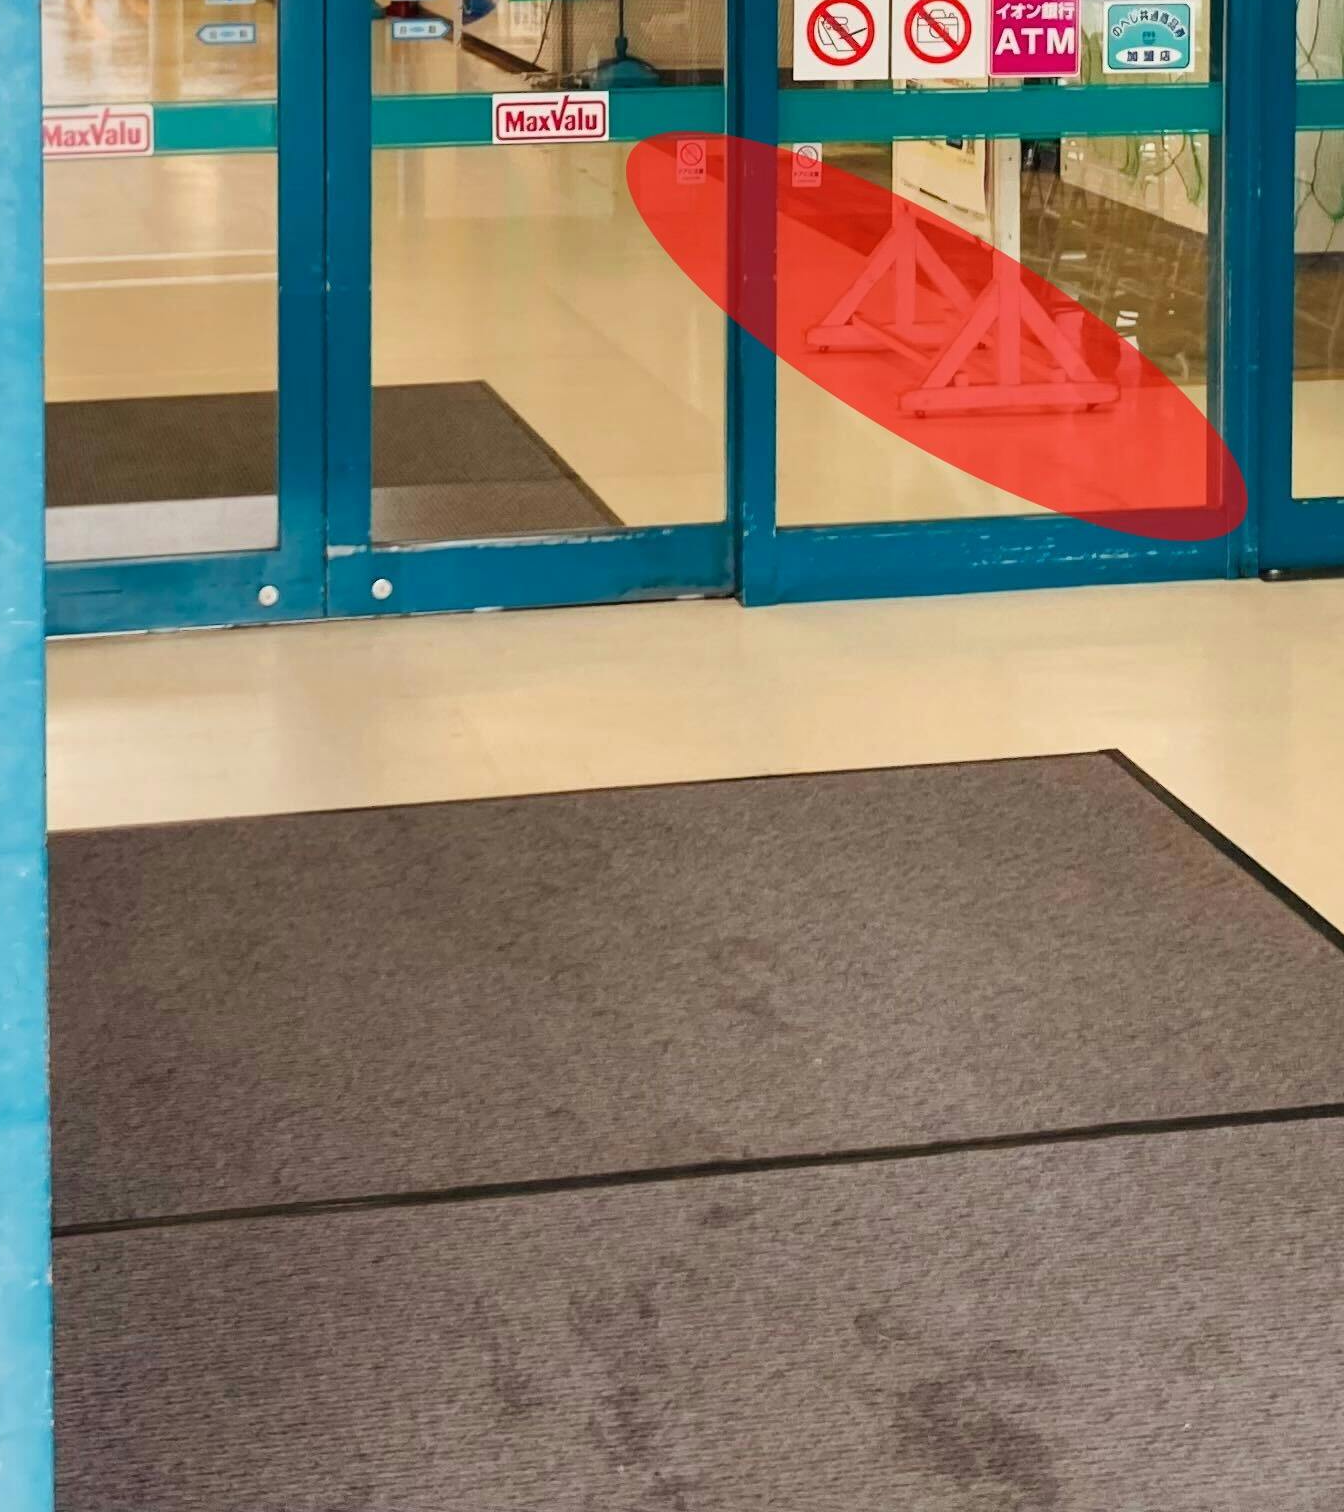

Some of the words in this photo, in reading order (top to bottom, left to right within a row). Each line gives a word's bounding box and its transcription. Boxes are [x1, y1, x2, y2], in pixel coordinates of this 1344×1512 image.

[996, 1, 1076, 20] イオン銀行
[995, 28, 1076, 55] ATM
[42, 108, 142, 147] MaxValu
[504, 96, 599, 134] MaxValu
